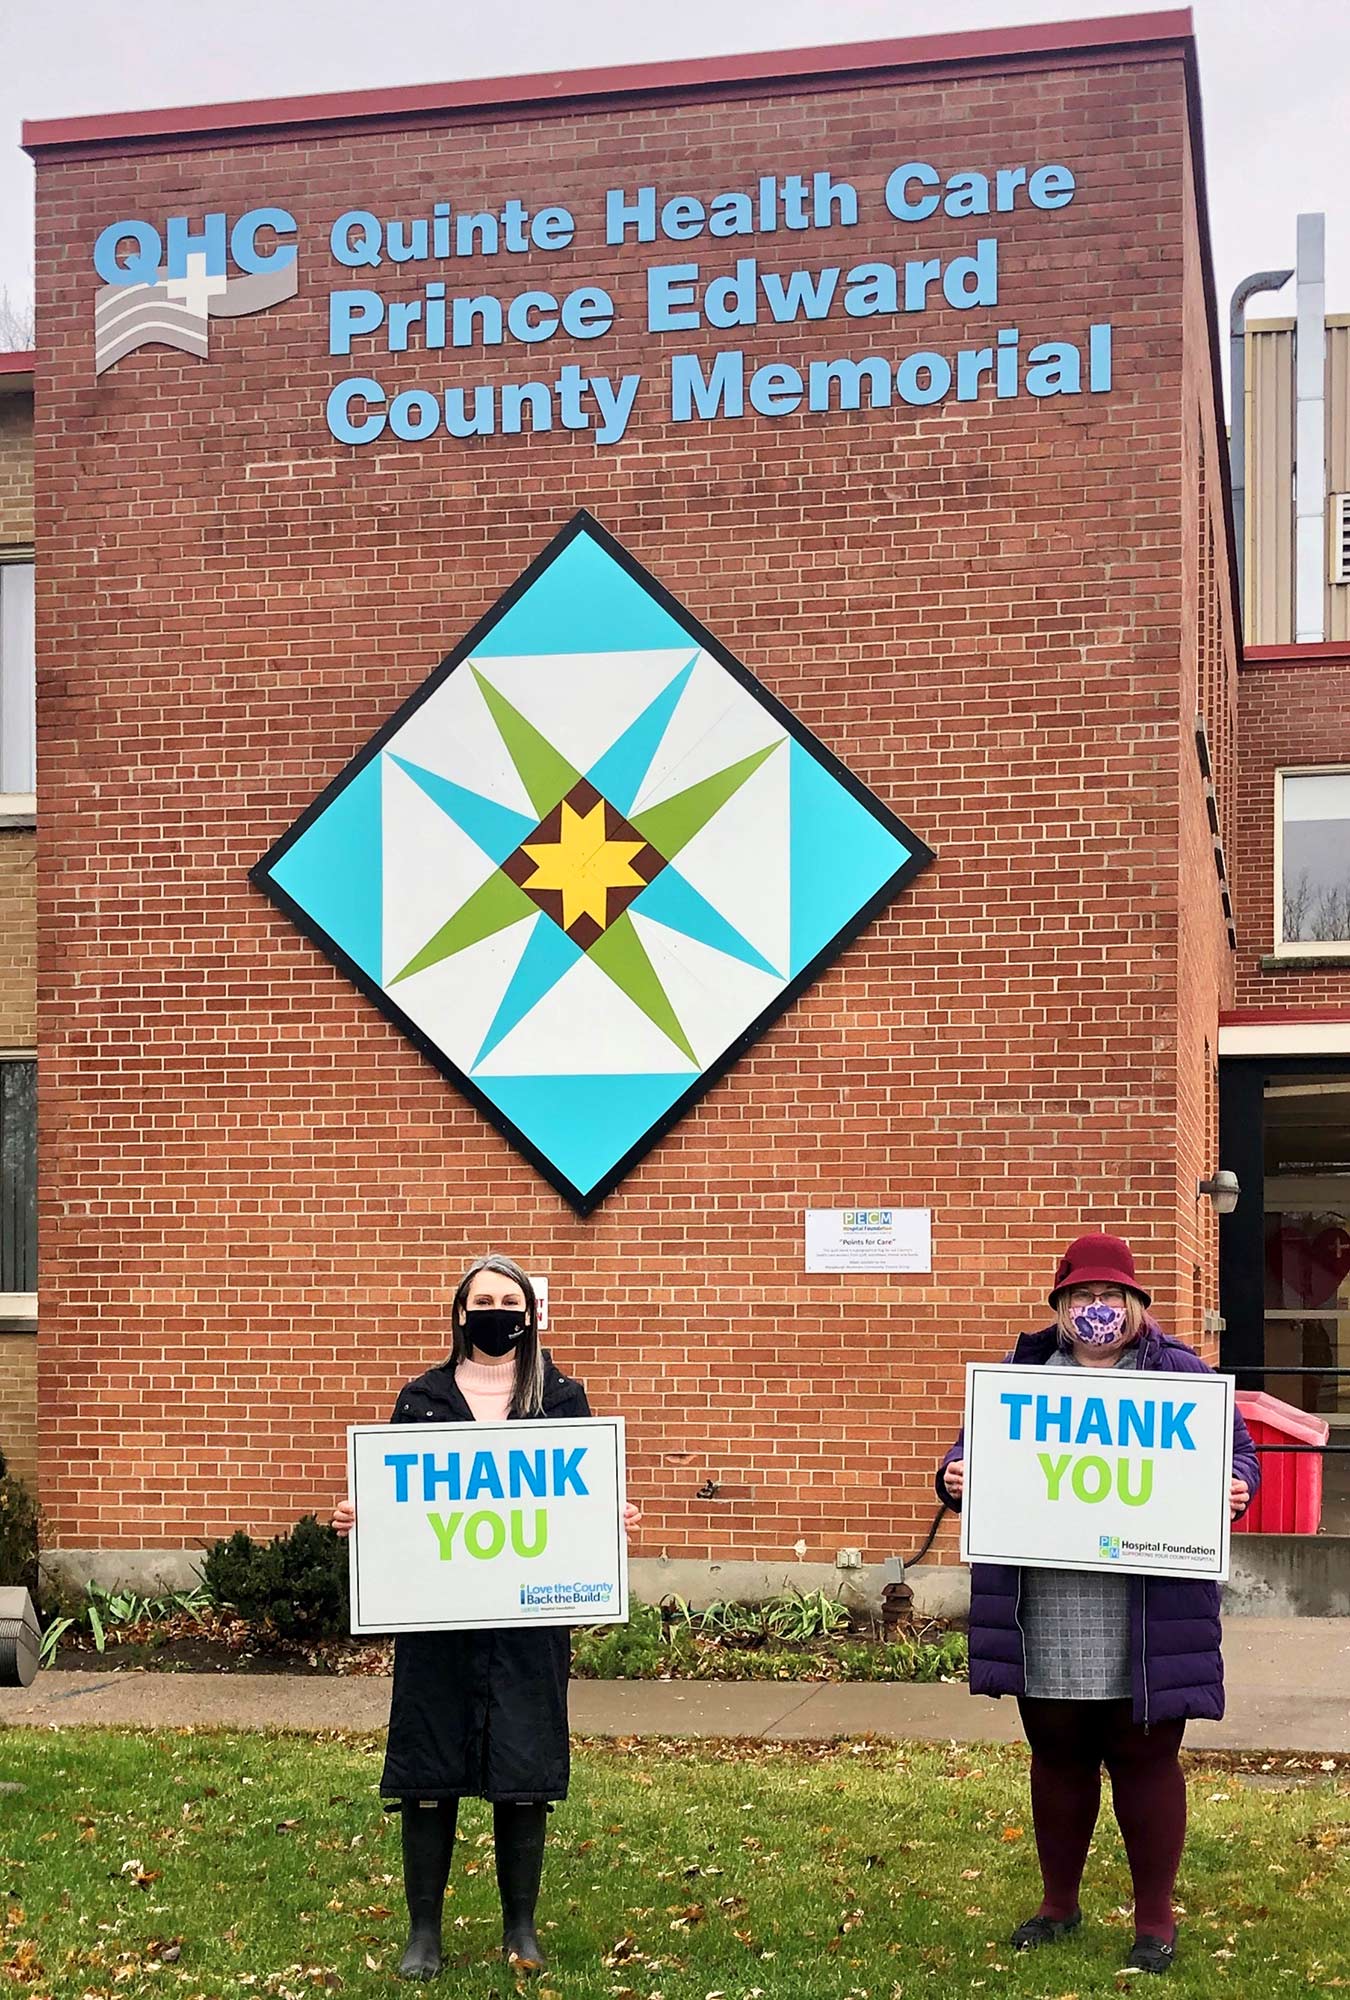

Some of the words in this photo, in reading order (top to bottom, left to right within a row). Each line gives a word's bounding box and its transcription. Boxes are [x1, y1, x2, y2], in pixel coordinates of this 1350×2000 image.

[331, 200, 574, 266] Quinte
[607, 172, 858, 245] Health
[885, 163, 1075, 221] Care
[94, 207, 298, 286] QHC
[330, 283, 613, 355] Prince
[648, 239, 997, 332] Edward
[327, 366, 640, 444] County
[672, 324, 1112, 421] Memorial
[843, 1212, 892, 1224] PECM
[1000, 1393, 1197, 1450] THANK
[384, 1448, 589, 1503] THANK
[1037, 1453, 1153, 1506] YOU
[427, 1509, 548, 1561] YOU
[1122, 1540, 1160, 1552] Hospital
[1162, 1543, 1215, 1555] Foundation
[527, 1585, 552, 1595] Love
[554, 1584, 572, 1593] the
[573, 1582, 613, 1593] County
[527, 1594, 553, 1604] Back
[555, 1594, 572, 1604] the
[573, 1592, 600, 1602] Build
